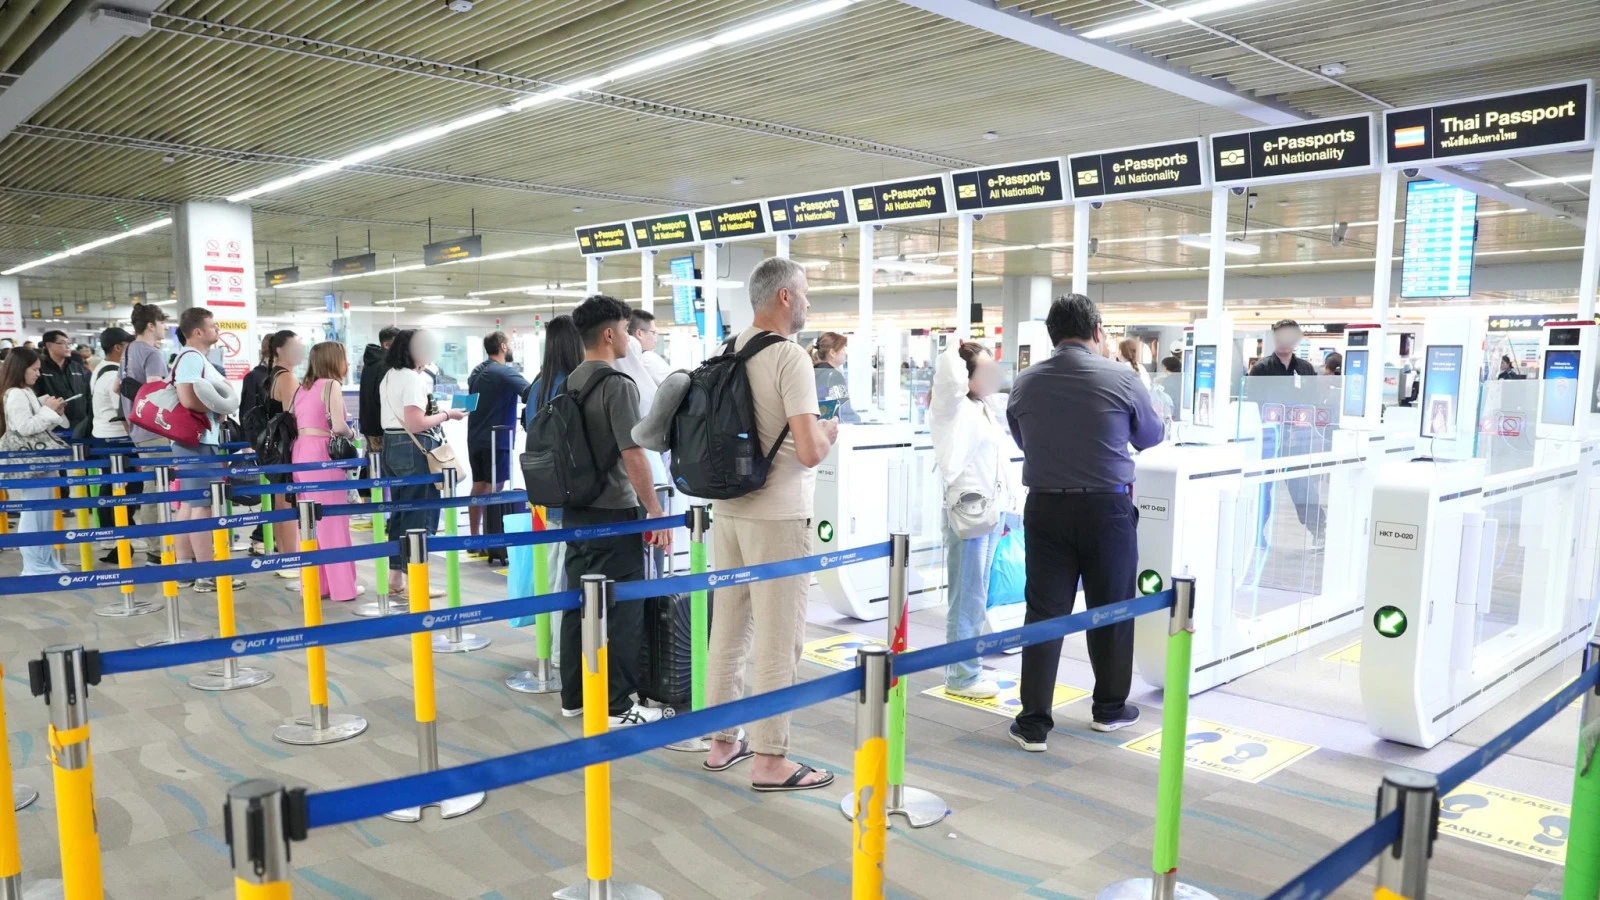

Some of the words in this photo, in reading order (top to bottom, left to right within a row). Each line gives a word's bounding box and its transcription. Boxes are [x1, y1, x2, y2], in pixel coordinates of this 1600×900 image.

[1440, 114, 1480, 133] Thai
[1486, 100, 1575, 124] Passport
[1263, 129, 1355, 152] e-Passports
[1113, 153, 1188, 172] e-Passports
[1264, 155, 1278, 167] All
[1282, 147, 1345, 165] Nationality
[987, 170, 1050, 187] e-Passports
[1114, 175, 1127, 185] All
[1128, 169, 1180, 184] Nationality
[883, 185, 936, 201] e-Passports
[990, 189, 1000, 199] All
[1001, 184, 1045, 197] Nationality
[794, 198, 839, 212] e-Passports
[885, 203, 894, 212] All
[895, 199, 931, 211] Nationality
[717, 210, 757, 222] e-Passports
[804, 210, 836, 221] Nationality
[727, 221, 754, 230] Nationality
[1394, 532, 1414, 540] D-020
[96, 573, 121, 581] PHUKET
[717, 574, 731, 582] AOT
[735, 571, 751, 579] PHUKET
[435, 614, 453, 623] AOT
[459, 610, 482, 619] PHUKET
[247, 639, 267, 648] AOT
[276, 634, 304, 644] PHUKET
[1216, 726, 1272, 744] PLEASE
[1198, 760, 1243, 775] HERE
[1485, 791, 1566, 813] PLEASE
[1496, 837, 1560, 858] HERE
